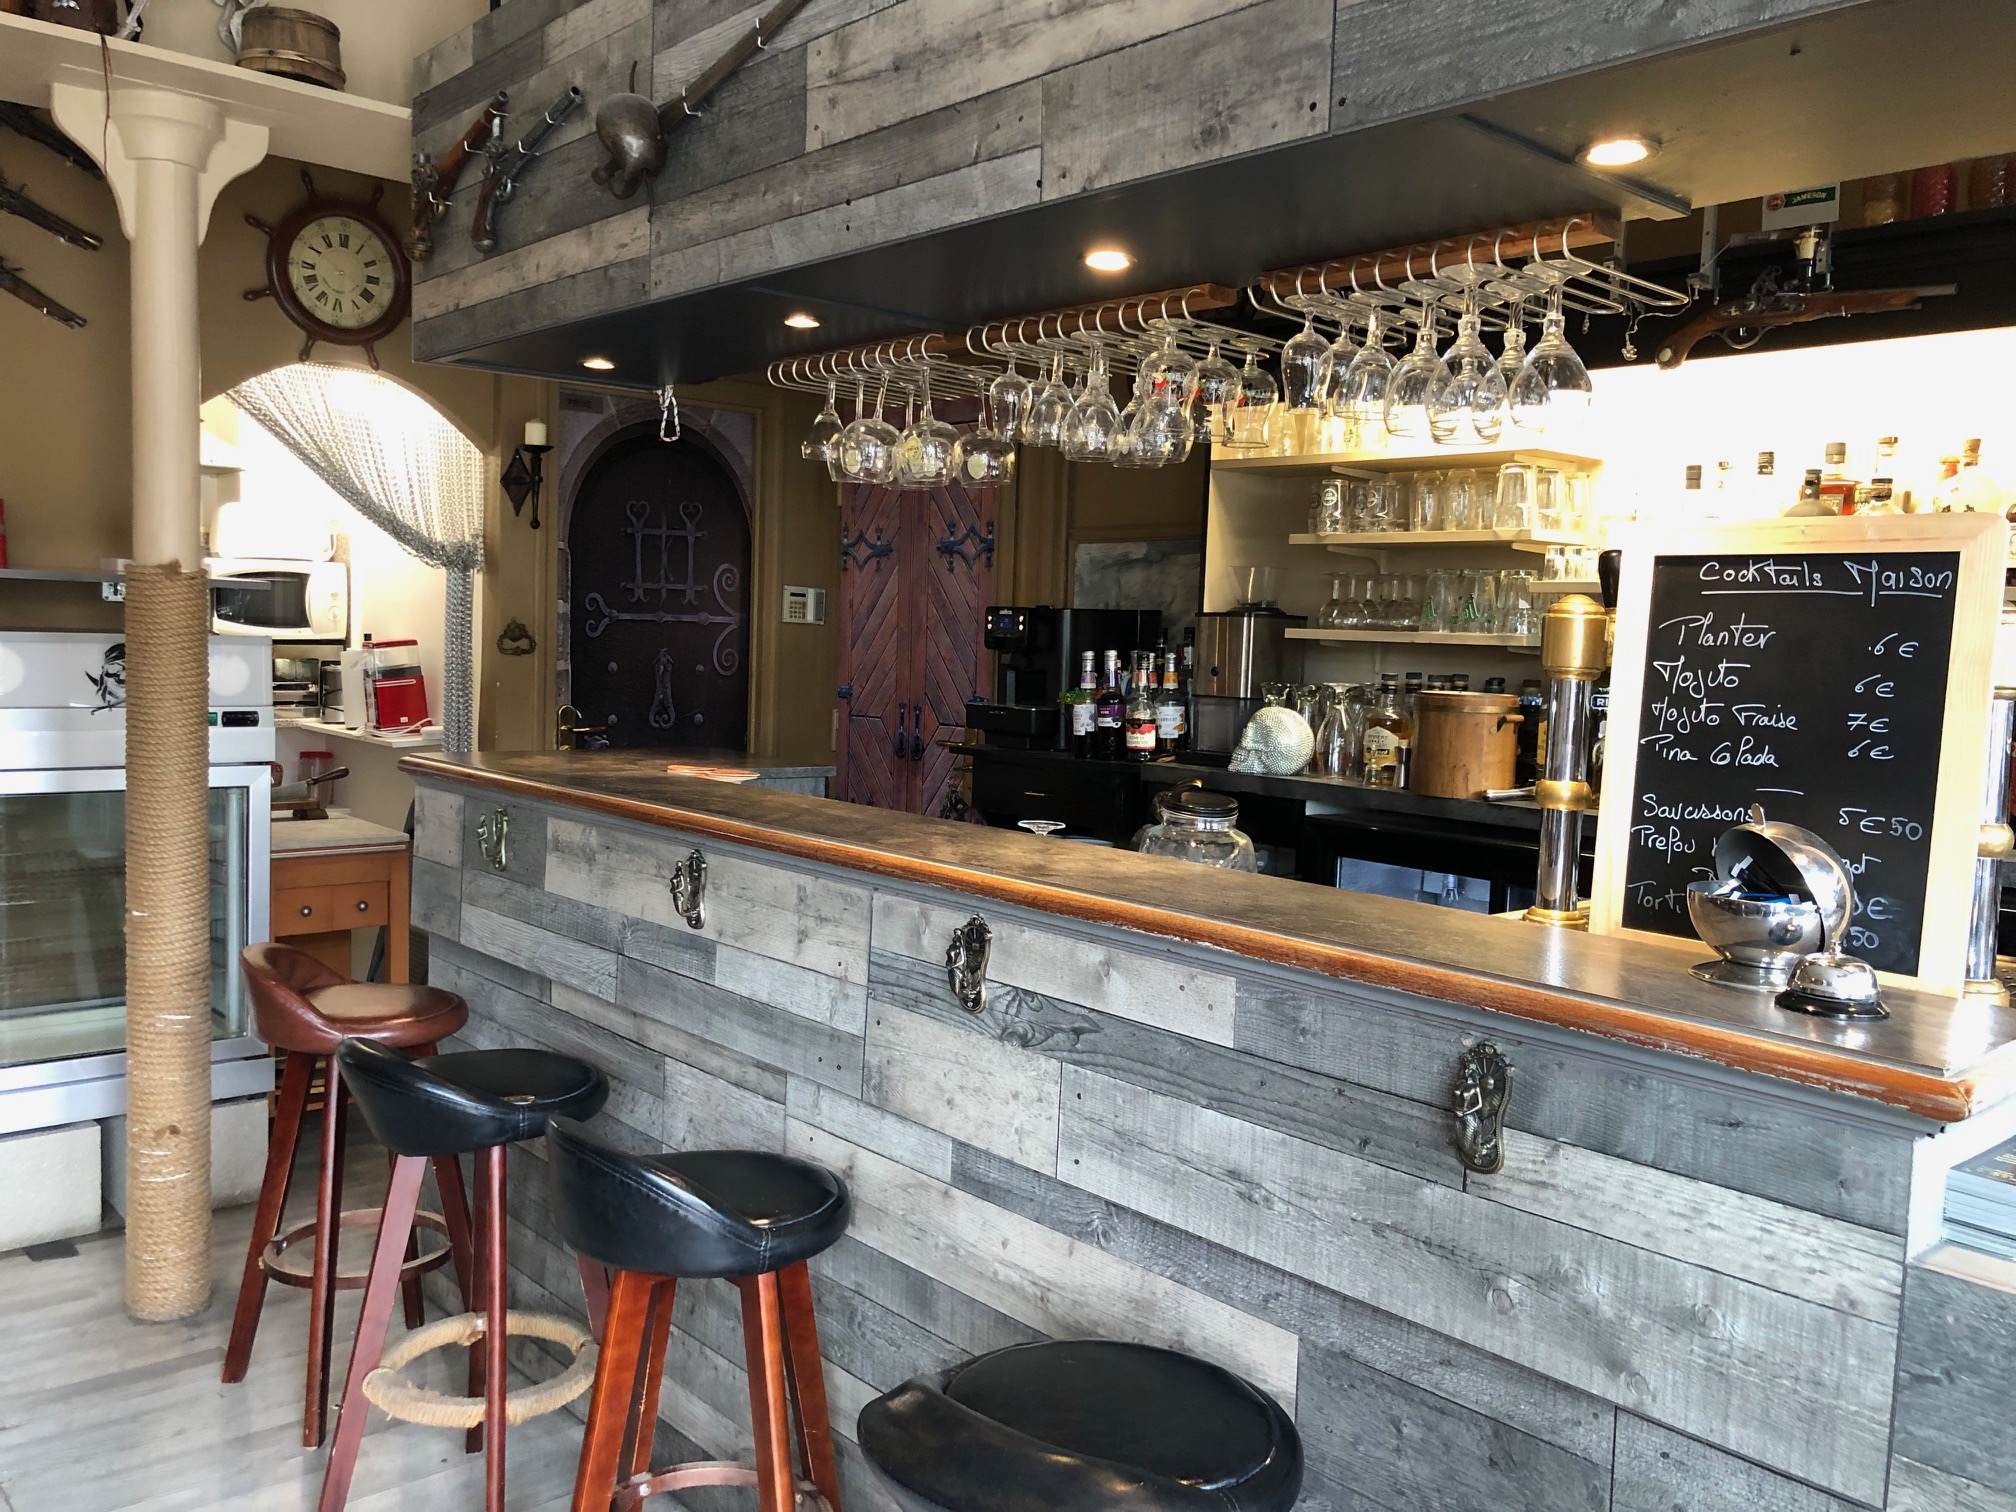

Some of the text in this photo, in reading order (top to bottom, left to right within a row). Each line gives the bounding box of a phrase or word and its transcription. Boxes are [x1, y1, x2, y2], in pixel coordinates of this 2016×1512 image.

[1792, 191, 1827, 204] JAMESON
[1843, 560, 1953, 607] Maison
[1658, 611, 1777, 649] Planter
[1731, 704, 1798, 731] Fraise
[1640, 733, 1698, 762] Pina
